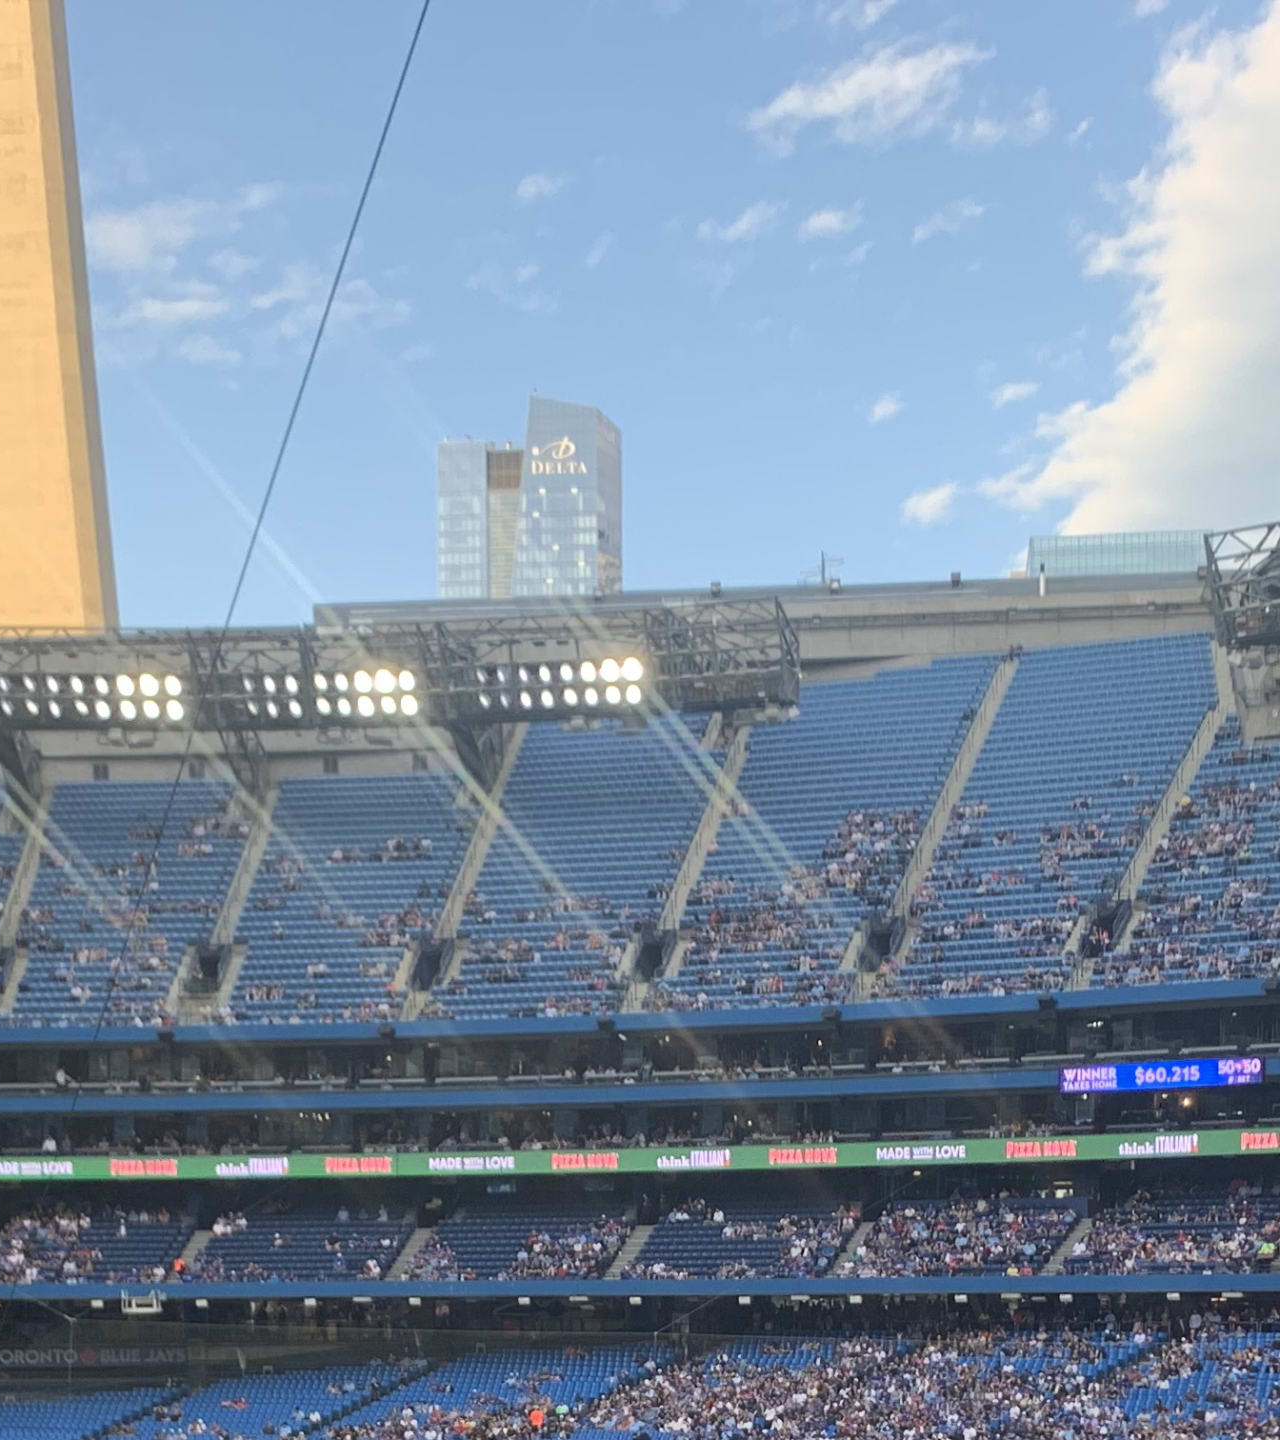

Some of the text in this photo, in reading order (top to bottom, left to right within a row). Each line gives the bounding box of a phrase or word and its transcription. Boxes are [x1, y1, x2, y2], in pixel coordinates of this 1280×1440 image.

[531, 460, 588, 475] DELTA
[1063, 1067, 1117, 1081] WINNER
[1119, 1140, 1154, 1155] think
[1241, 1131, 1279, 1150] PIZZA
[876, 1147, 910, 1161] MADE
[935, 1145, 966, 1159] LOVE
[43, 1161, 73, 1175] LOVE
[429, 1156, 462, 1171] MADE
[486, 1156, 515, 1170] LOVE
[657, 1156, 691, 1168] think
